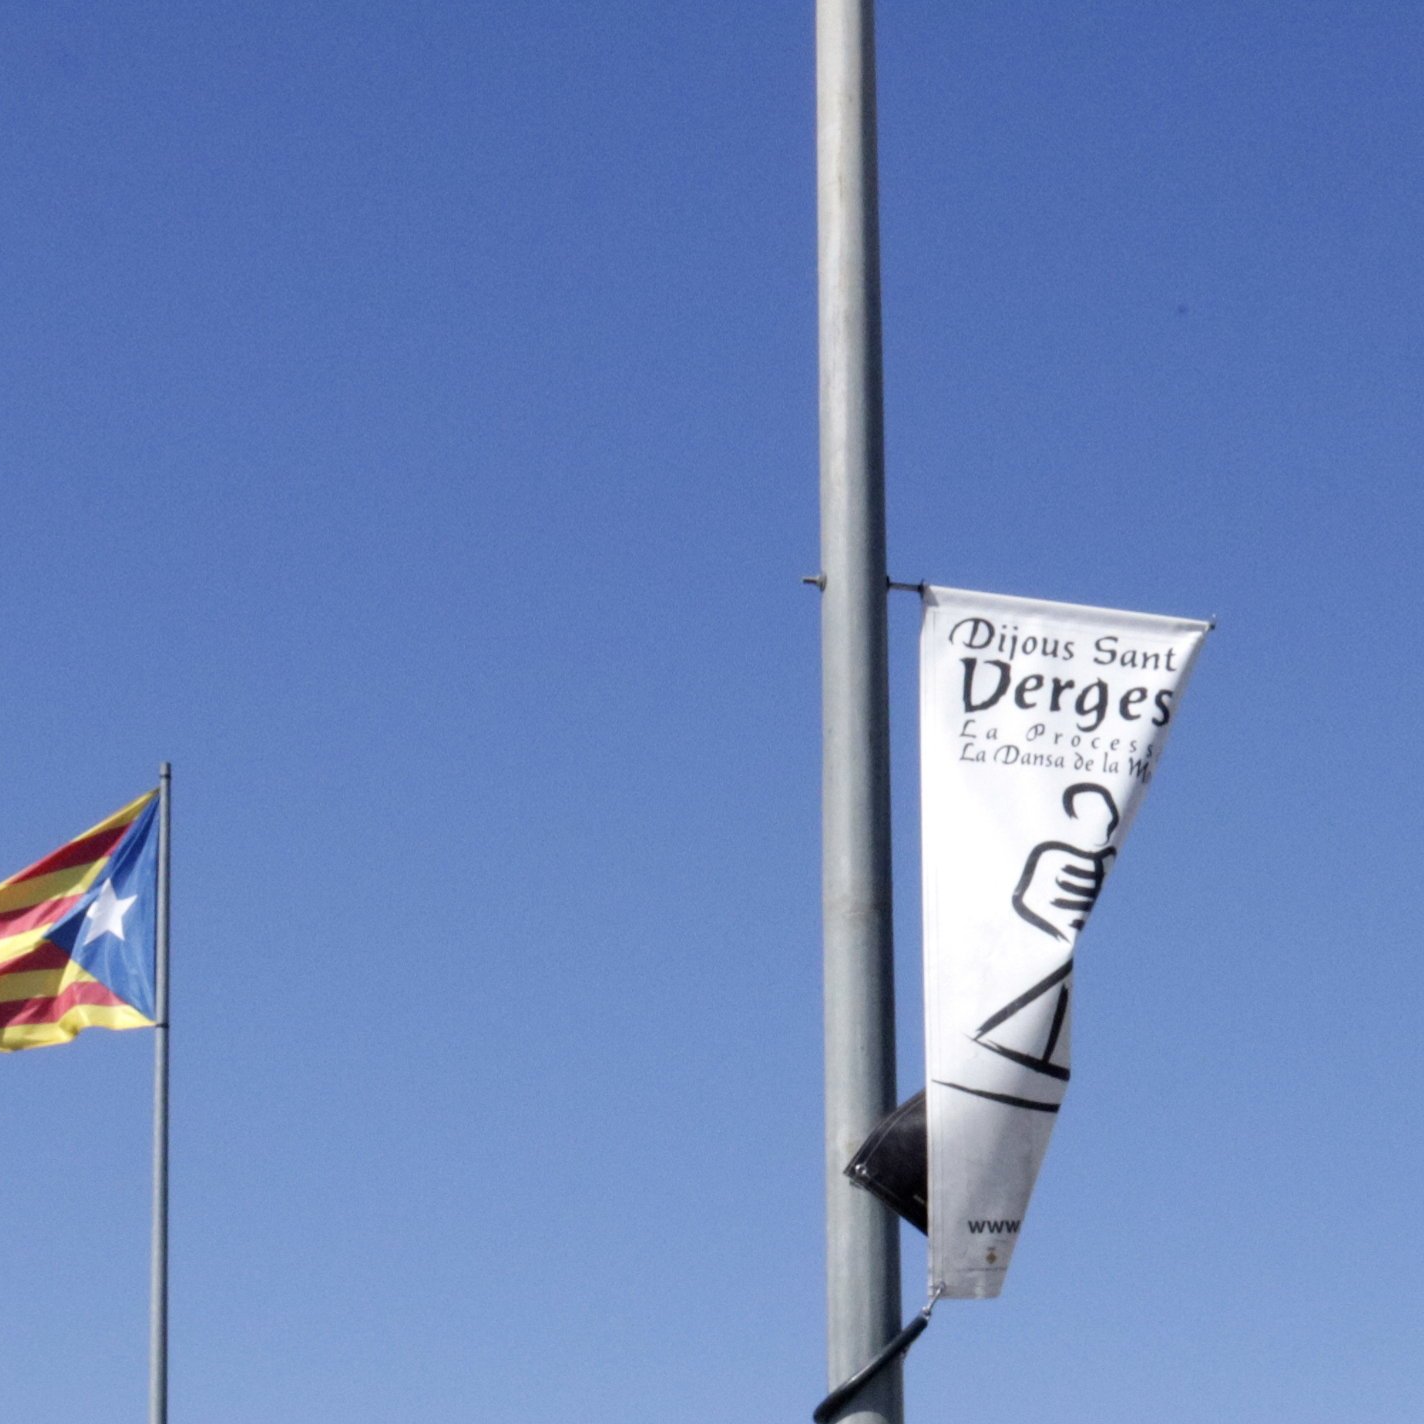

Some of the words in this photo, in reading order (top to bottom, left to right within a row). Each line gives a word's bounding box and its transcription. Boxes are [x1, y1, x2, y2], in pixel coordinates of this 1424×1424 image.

[949, 618, 1074, 660] Dijous
[1093, 636, 1177, 672] Sant
[960, 657, 1174, 732] Verges
[960, 720, 998, 740] La
[960, 743, 986, 763] La
[994, 745, 1065, 769] Dansa
[1074, 752, 1094, 772] de
[1102, 752, 1119, 774] la
